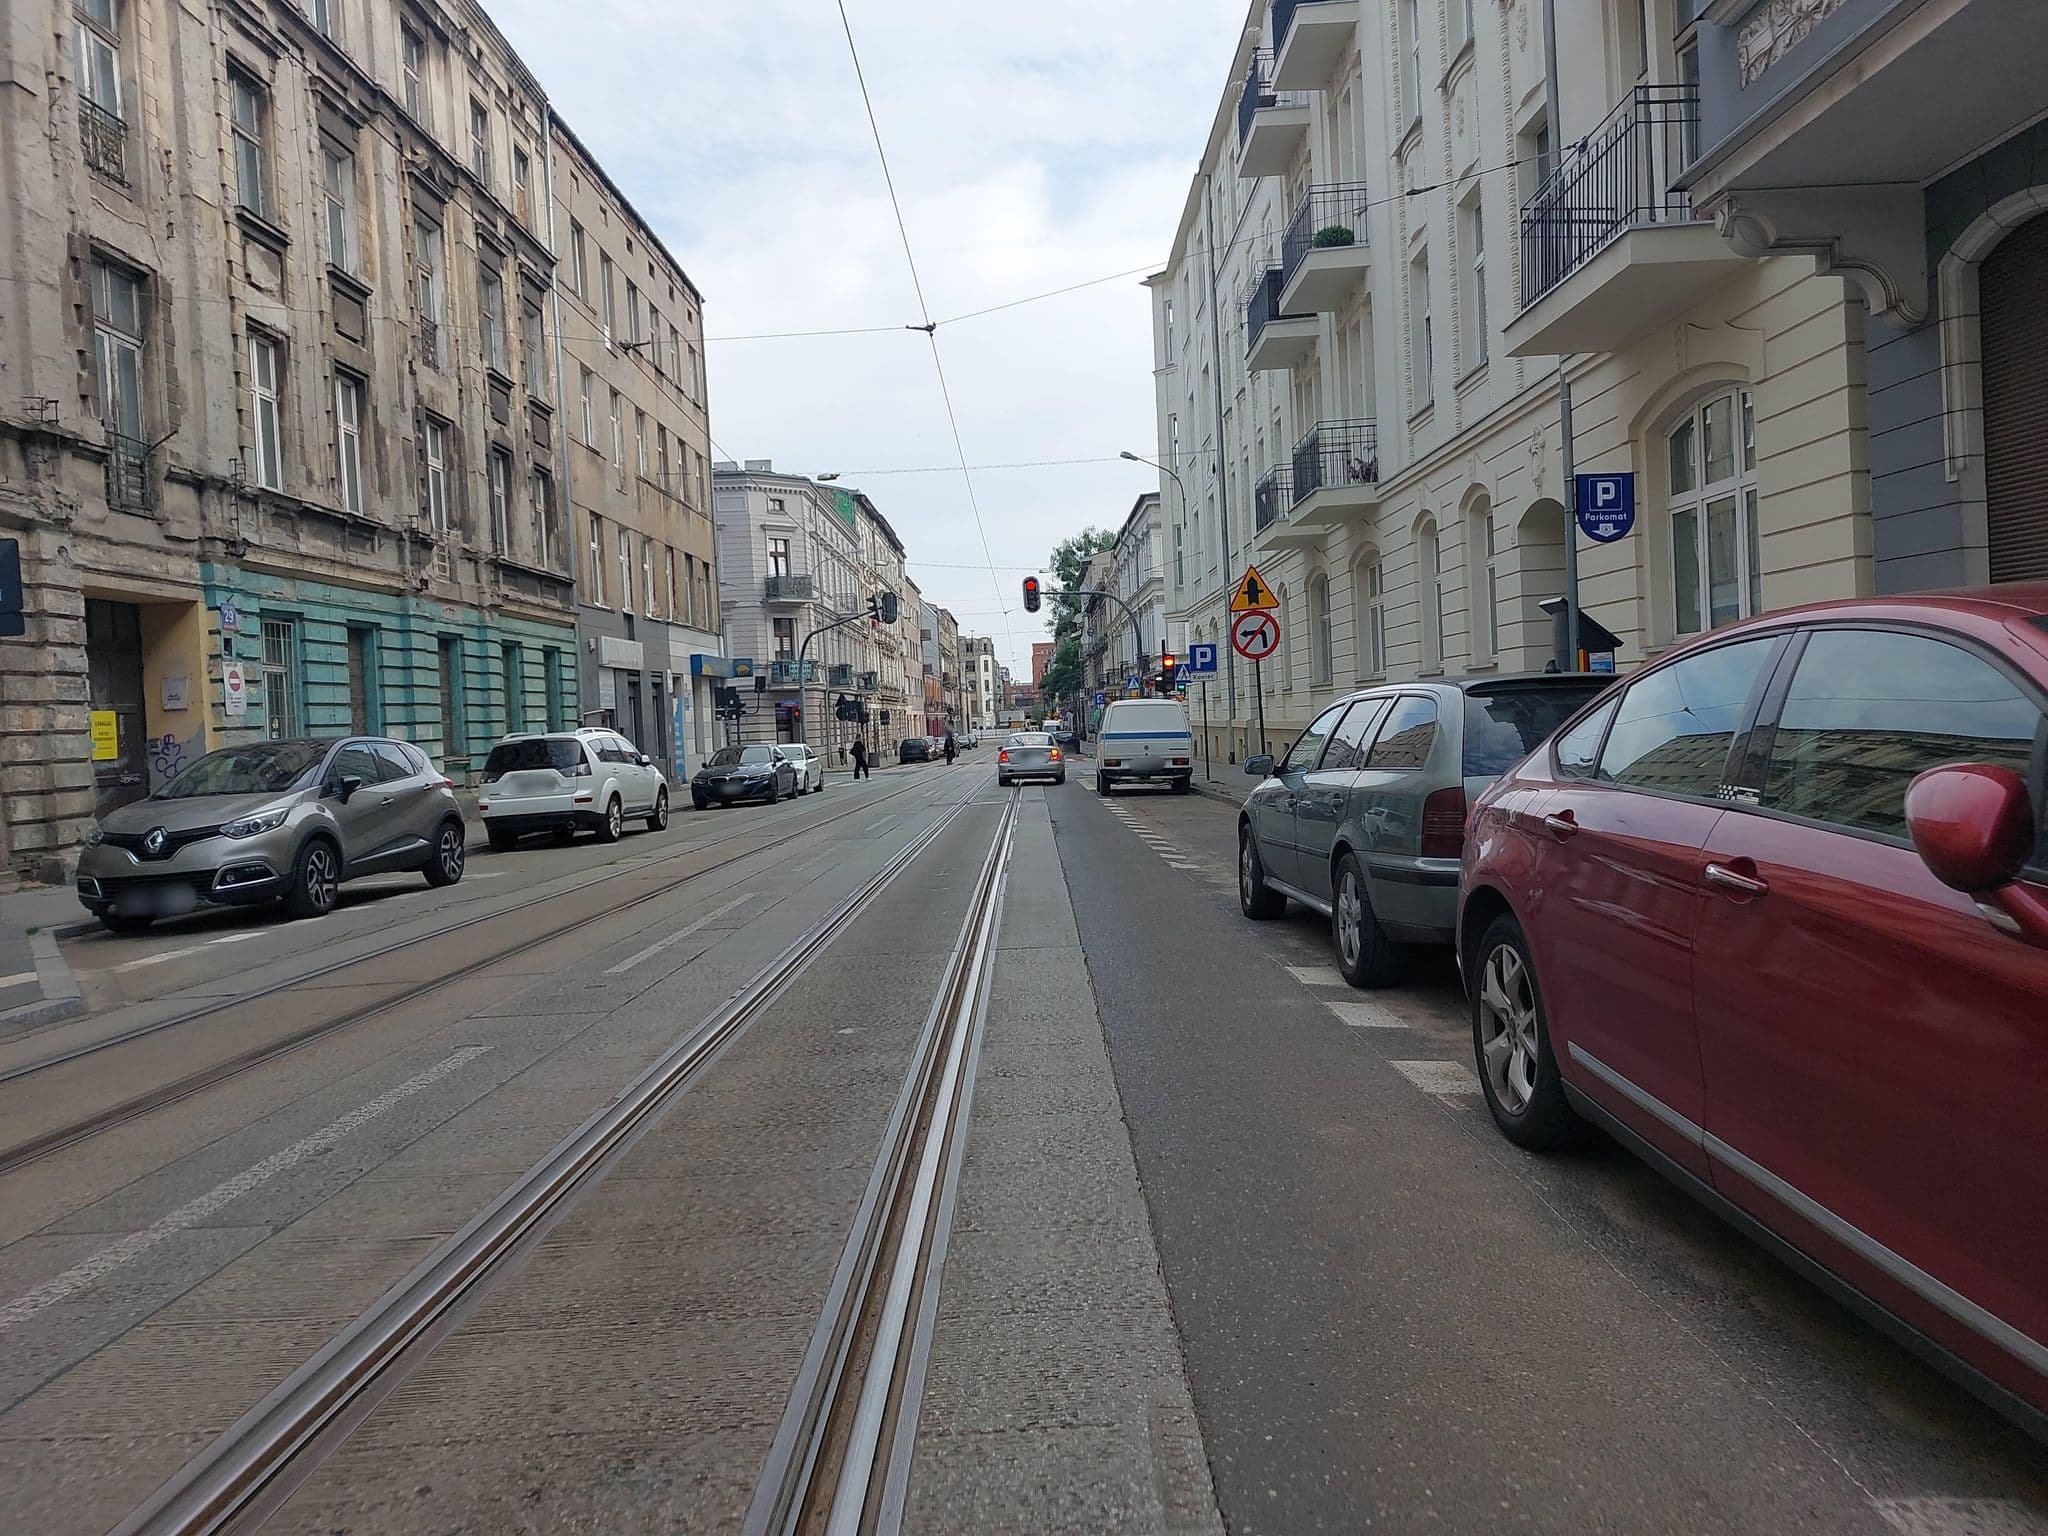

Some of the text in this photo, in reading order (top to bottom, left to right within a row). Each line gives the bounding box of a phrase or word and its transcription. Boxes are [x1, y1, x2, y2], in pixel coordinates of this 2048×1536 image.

[1597, 481, 1616, 507] P
[1585, 512, 1627, 521] Parkomat
[224, 610, 234, 623] 29
[1195, 647, 1212, 669] P
